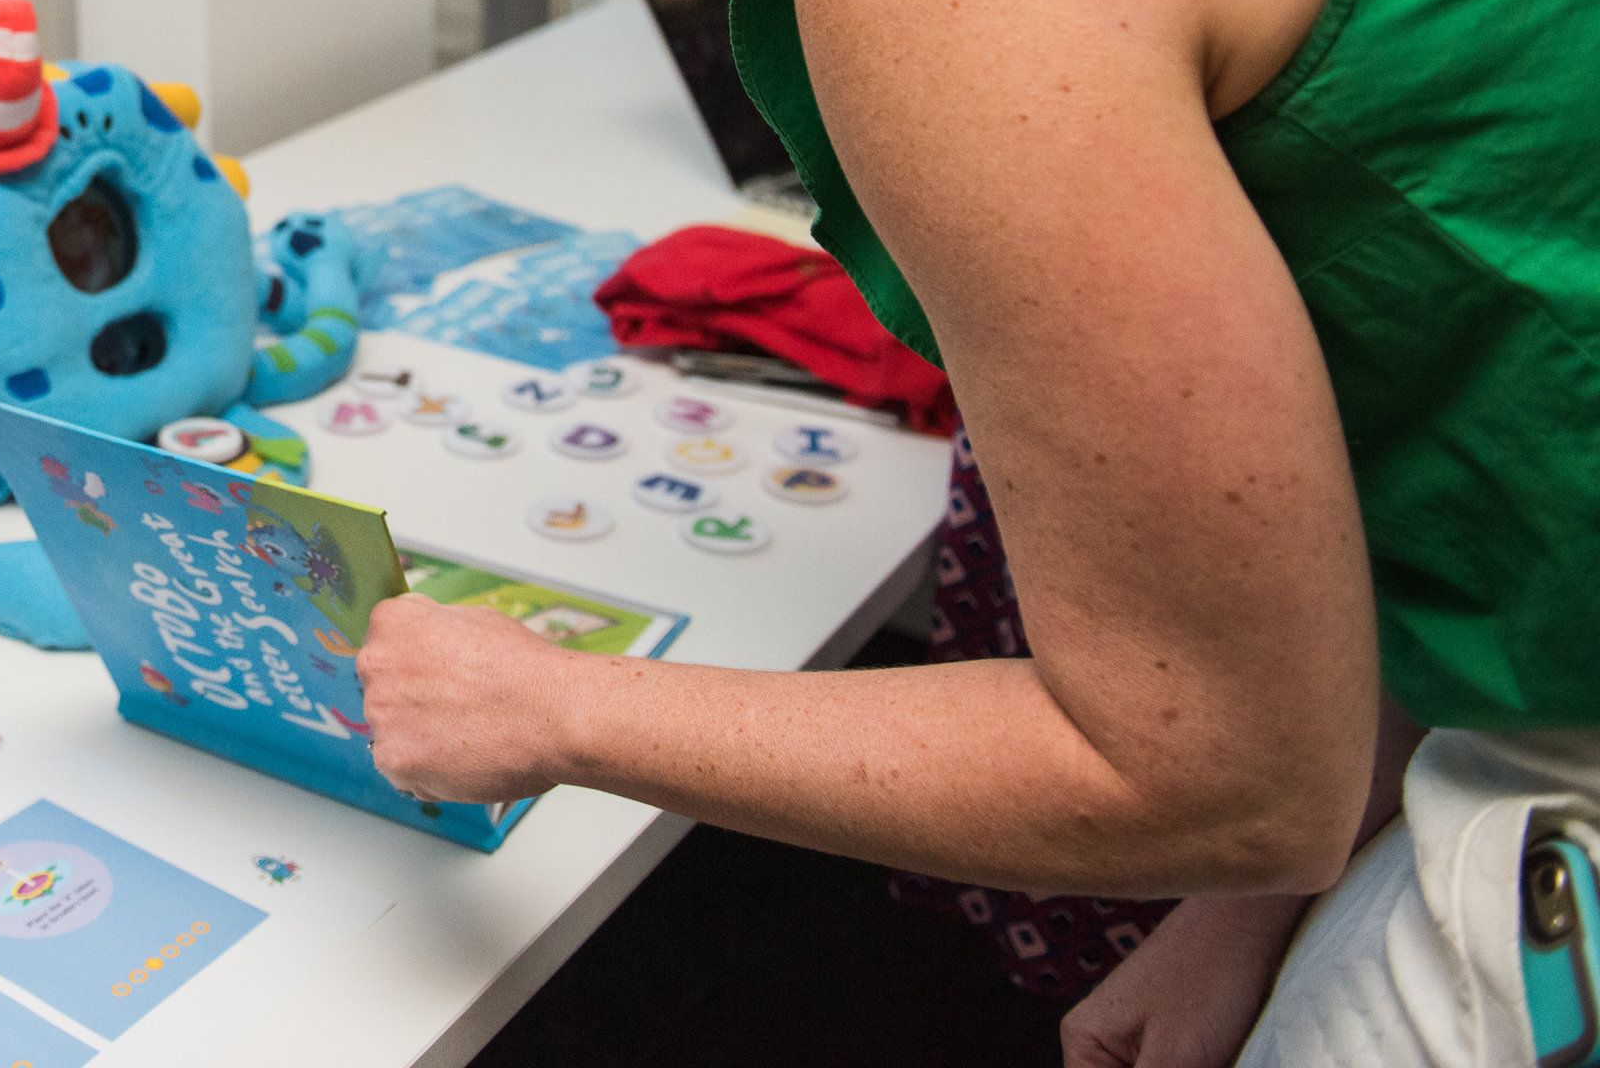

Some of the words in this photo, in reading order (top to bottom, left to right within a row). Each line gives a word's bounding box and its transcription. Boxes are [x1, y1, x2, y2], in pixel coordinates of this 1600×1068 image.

[141, 511, 223, 606] Great
[187, 529, 299, 646] Search
[210, 612, 244, 650] the
[226, 657, 273, 706] and
[260, 639, 351, 740] Letter
